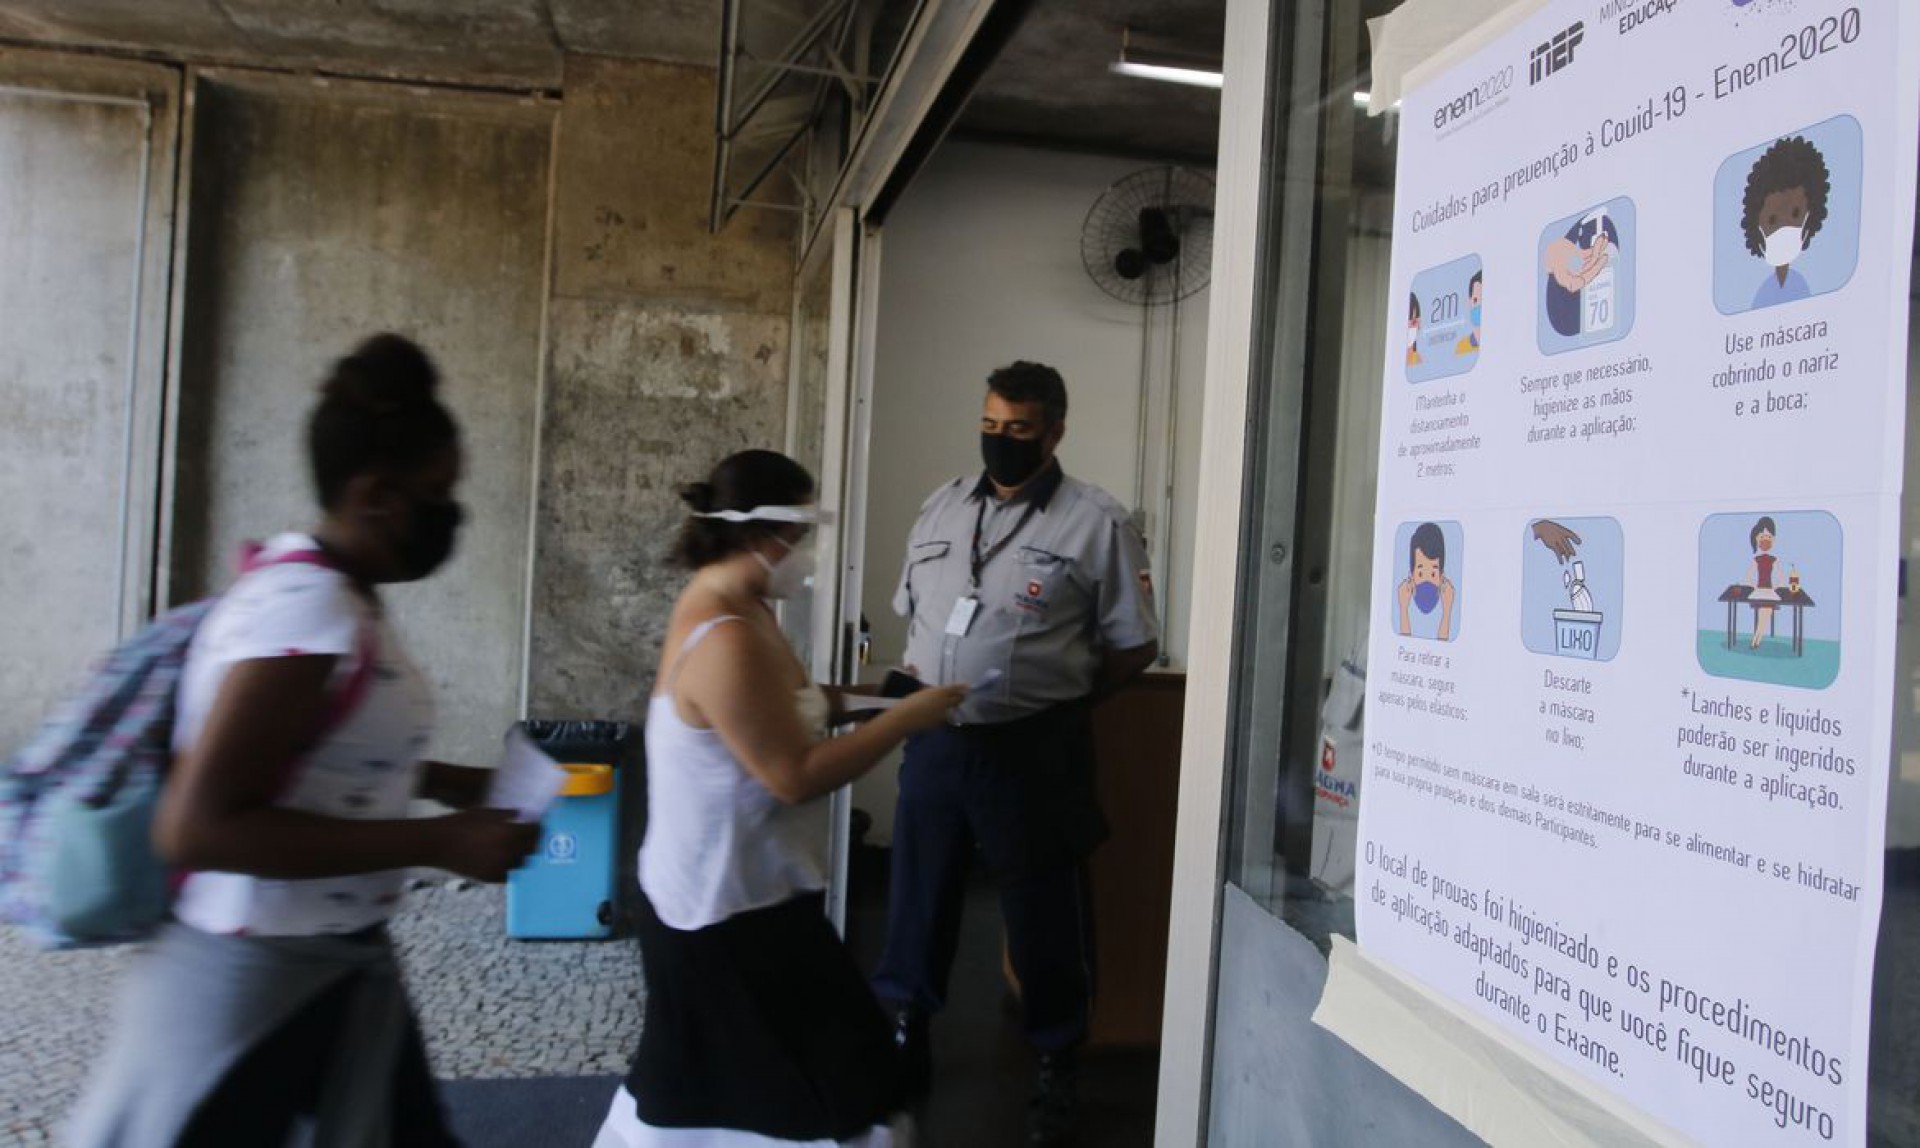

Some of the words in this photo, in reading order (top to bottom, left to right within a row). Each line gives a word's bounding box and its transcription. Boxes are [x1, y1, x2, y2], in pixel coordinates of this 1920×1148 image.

[1619, 0, 1677, 34] EDUCAÇ
[1412, 193, 1467, 234] Cuidados
[1472, 180, 1499, 216] para
[1585, 131, 1594, 156] à
[1714, 7, 1860, 100] Enem2020
[1590, 299, 1609, 326] 70
[1725, 332, 1754, 355] Use
[1760, 320, 1828, 349] máscara
[1520, 374, 1560, 395] Sempre
[1563, 369, 1582, 391] que
[1586, 353, 1653, 382] necessário,
[1712, 357, 1775, 388] cobrindo
[1782, 361, 1792, 378] o
[1798, 347, 1839, 375] nariz
[1533, 394, 1579, 421] higienize
[1583, 394, 1596, 409] as
[1600, 387, 1633, 407] mãos
[1735, 400, 1744, 416] e
[1750, 399, 1760, 415] a
[1527, 424, 1566, 443] durante
[1570, 424, 1576, 438] a
[1561, 628, 1592, 652] LIXO
[1544, 668, 1592, 695] Descarte
[1539, 701, 1546, 714] a
[1550, 701, 1595, 724] máscara
[1760, 708, 1769, 724] e
[1775, 702, 1842, 737] líquidos
[1545, 727, 1559, 744] no
[1677, 723, 1736, 752] poderão
[1743, 738, 1769, 758] ser
[1775, 738, 1855, 776] ingeridos
[1683, 754, 1737, 786] durante
[1744, 773, 1754, 789] a
[1760, 773, 1844, 811] aplicação.
[1498, 800, 1532, 826] demais
[1502, 781, 1519, 796] em
[1521, 783, 1540, 803] sala
[1543, 792, 1564, 811] será
[1567, 800, 1631, 832] estritamente
[1634, 820, 1660, 842] para
[1665, 830, 1681, 848] se
[1686, 832, 1752, 868] alimentar
[1757, 856, 1766, 873] e
[1773, 861, 1791, 880] se
[1798, 861, 1861, 902] hidratar
[1365, 840, 1375, 865] O
[1380, 844, 1407, 879] local
[1412, 859, 1428, 888] de
[1484, 889, 1504, 923] foi
[1509, 899, 1599, 969] higienizado
[1607, 954, 1618, 978] e
[1627, 964, 1650, 994] os
[1660, 977, 1843, 1086] procedimentos
[1371, 879, 1386, 907] de
[1391, 892, 1449, 938] aplicação
[1453, 922, 1529, 979] adaptados
[1534, 964, 1571, 1002] para
[1579, 987, 1612, 1024] que
[1677, 1027, 1736, 1085] fique
[1747, 1072, 1834, 1141] seguro
[1475, 970, 1531, 1025] durante
[1537, 1012, 1547, 1035] o
[1555, 1013, 1625, 1079] Exame.
